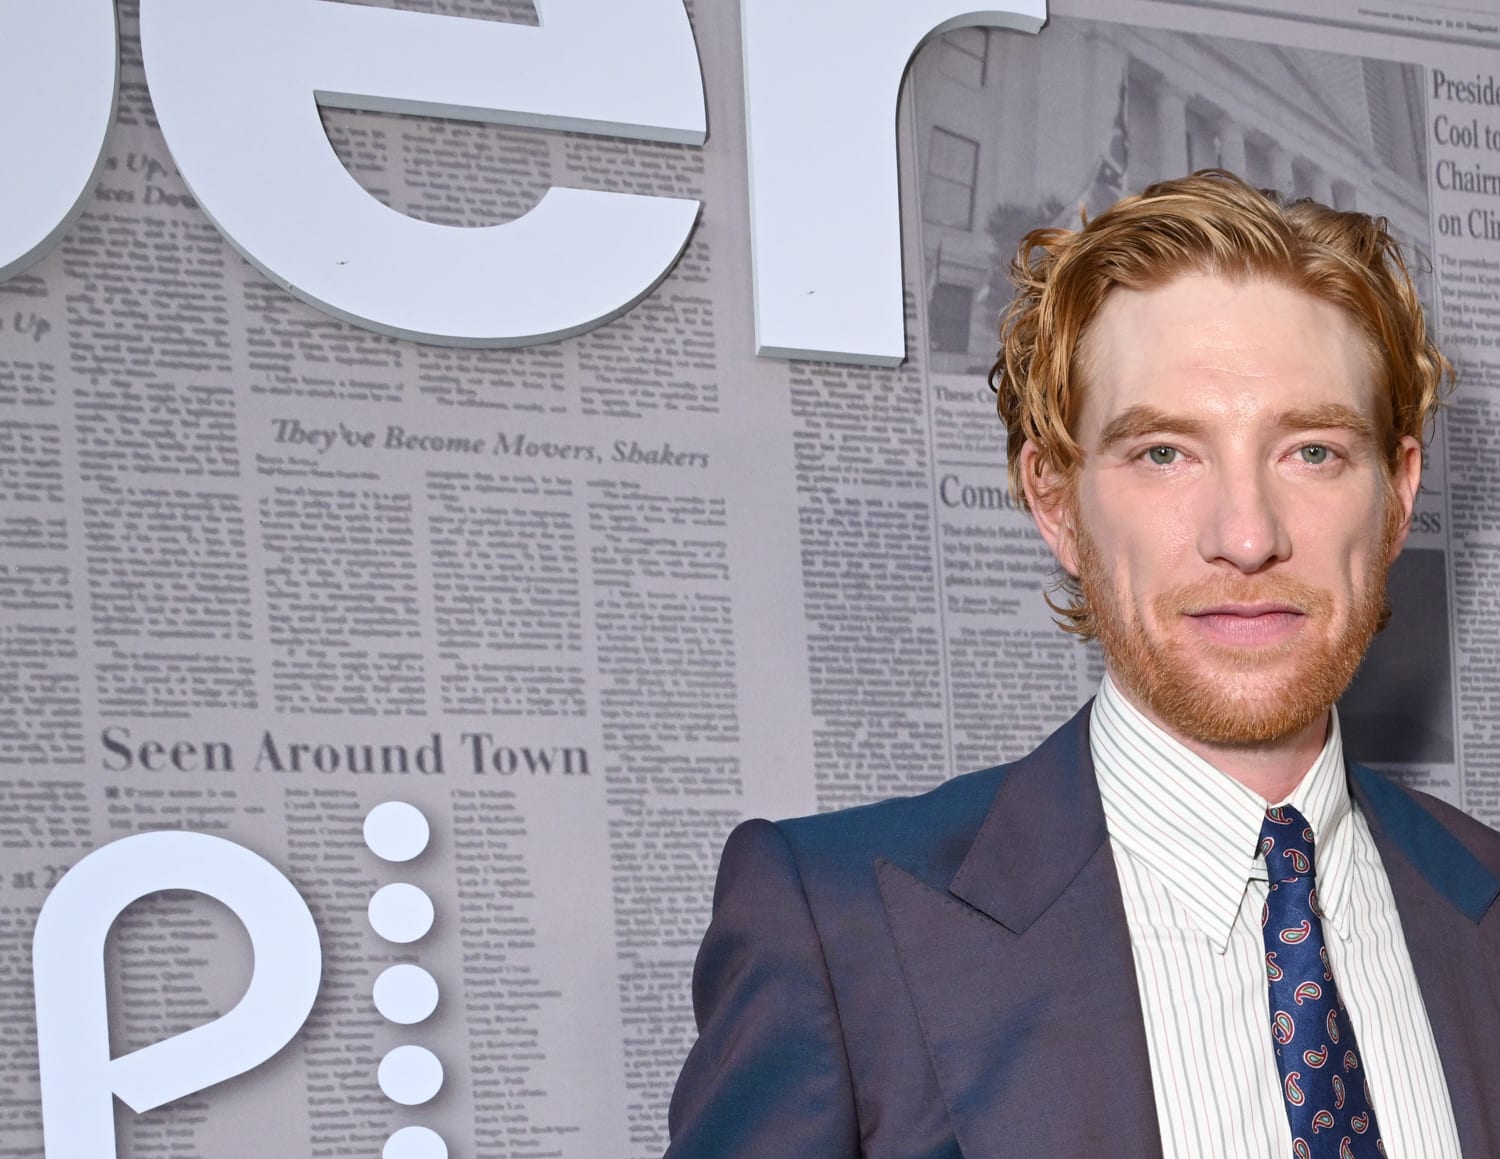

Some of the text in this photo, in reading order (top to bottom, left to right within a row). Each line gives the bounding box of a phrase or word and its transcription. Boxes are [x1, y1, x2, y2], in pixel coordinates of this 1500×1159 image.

[1434, 113, 1479, 150] Cool
[1438, 213, 1462, 238] on
[384, 425, 486, 456] Become
[493, 430, 604, 466] Movers,
[610, 440, 710, 470] Shakers
[100, 723, 592, 777] Seen Around Town
